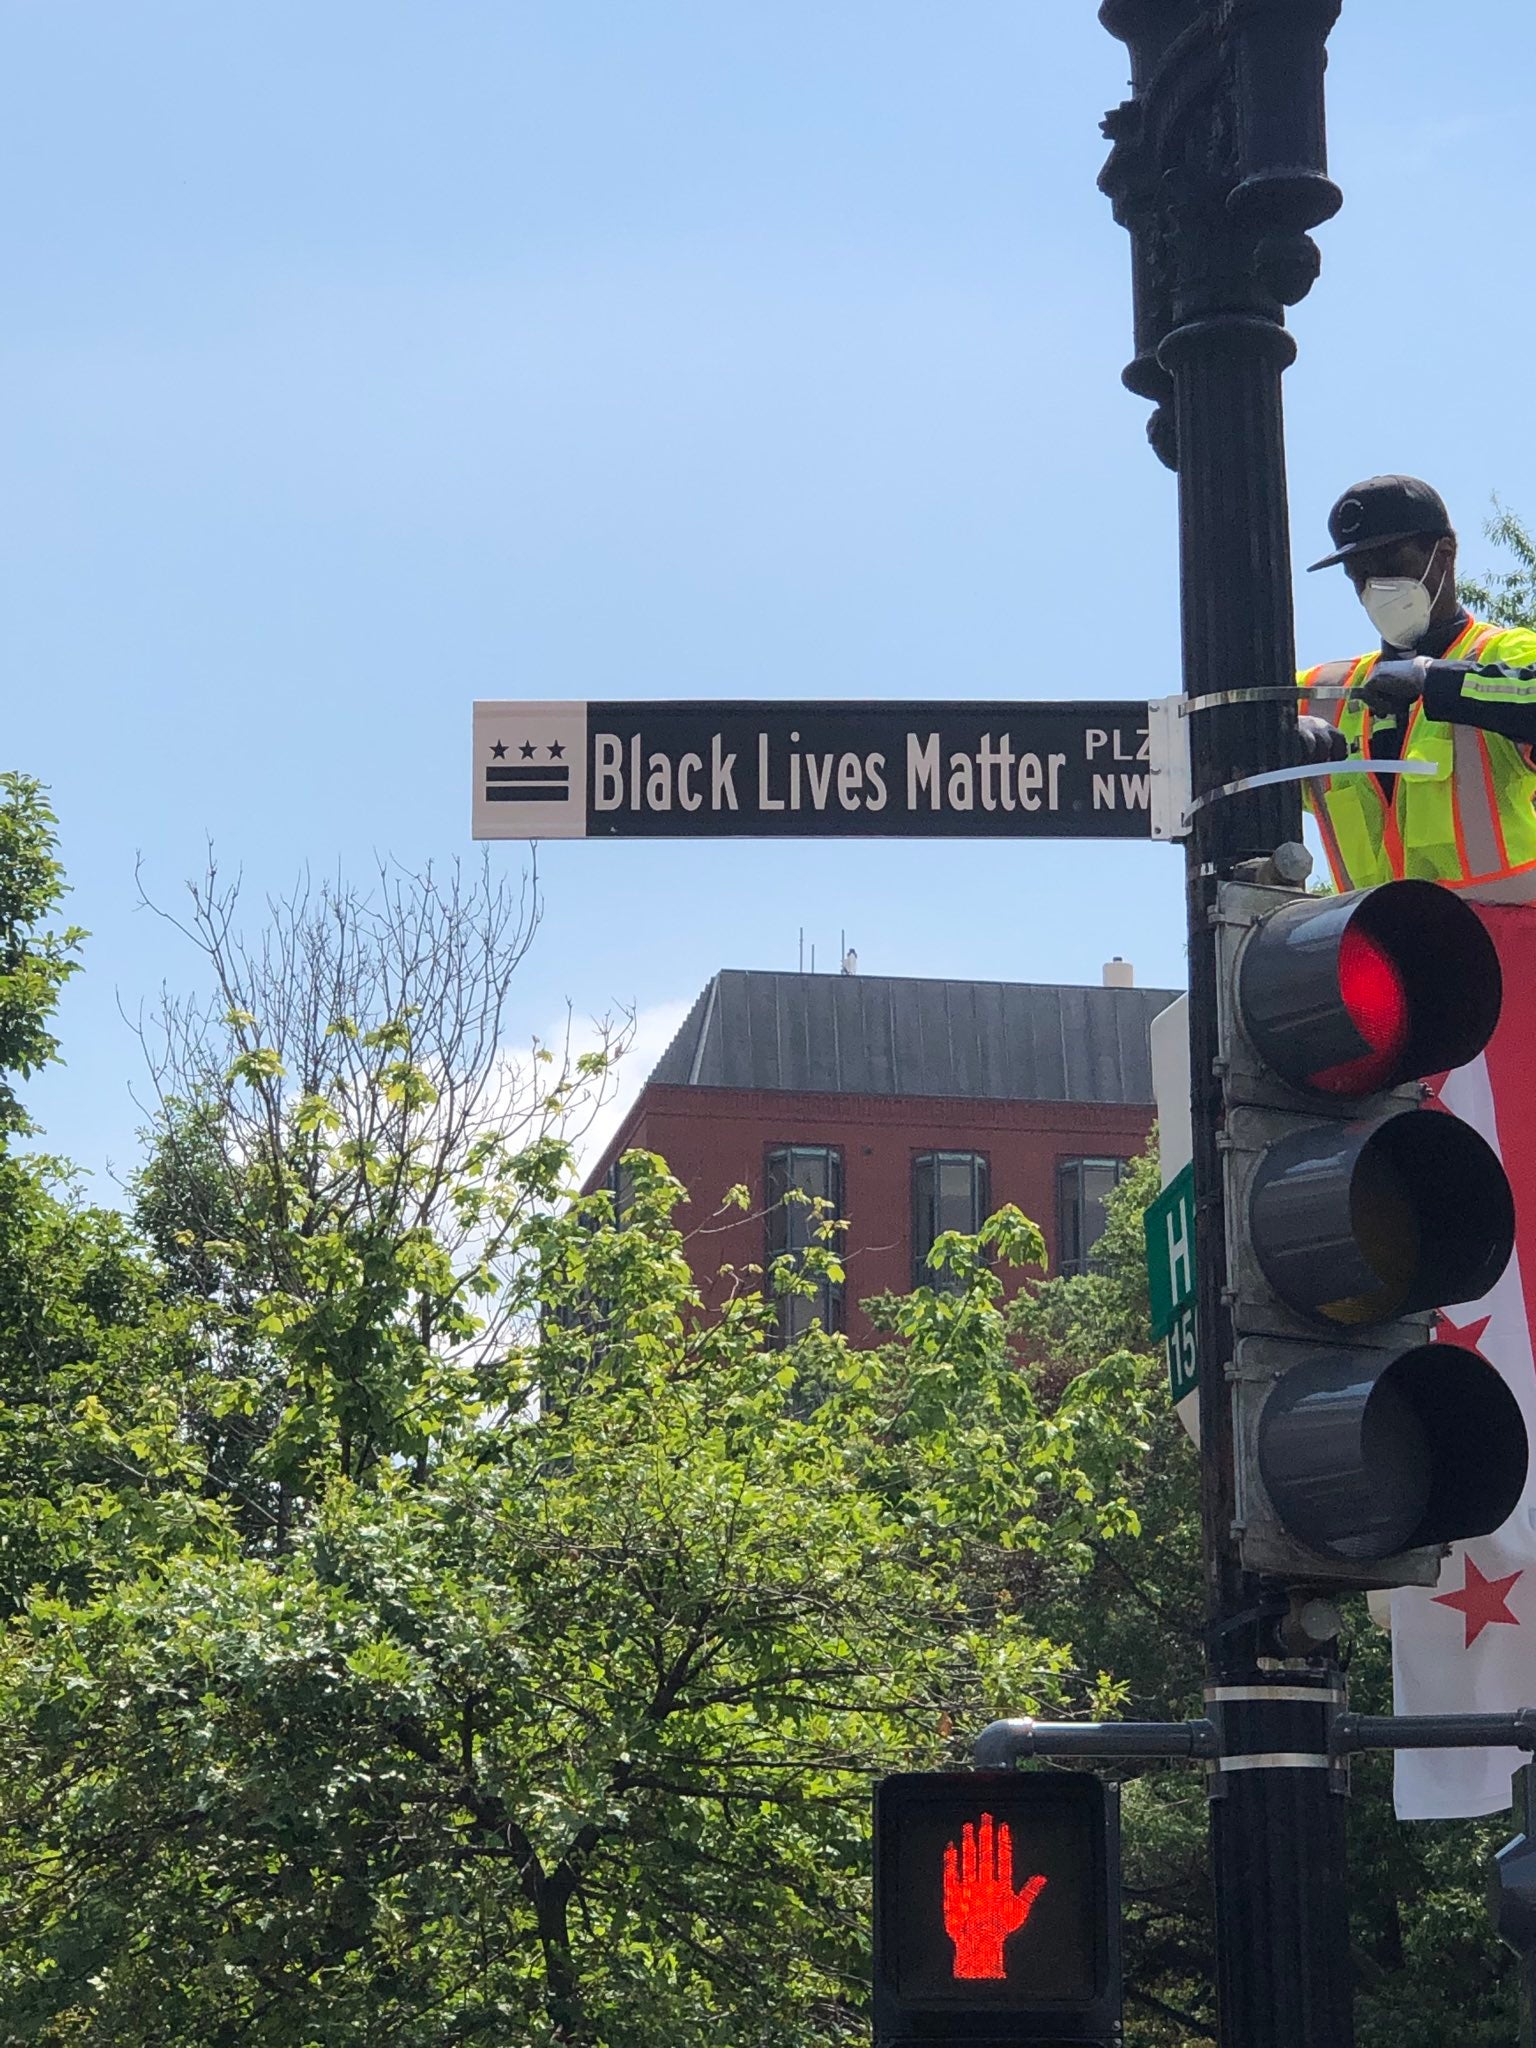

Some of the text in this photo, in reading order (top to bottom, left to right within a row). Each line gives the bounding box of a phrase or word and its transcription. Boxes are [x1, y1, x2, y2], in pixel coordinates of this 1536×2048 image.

[595, 731, 1066, 811] Black Lives Matter
[1085, 728, 1150, 761] PLZ
[1092, 773, 1150, 810] NW
[1166, 1196, 1191, 1307] H
[1171, 1305, 1198, 1386] 15
